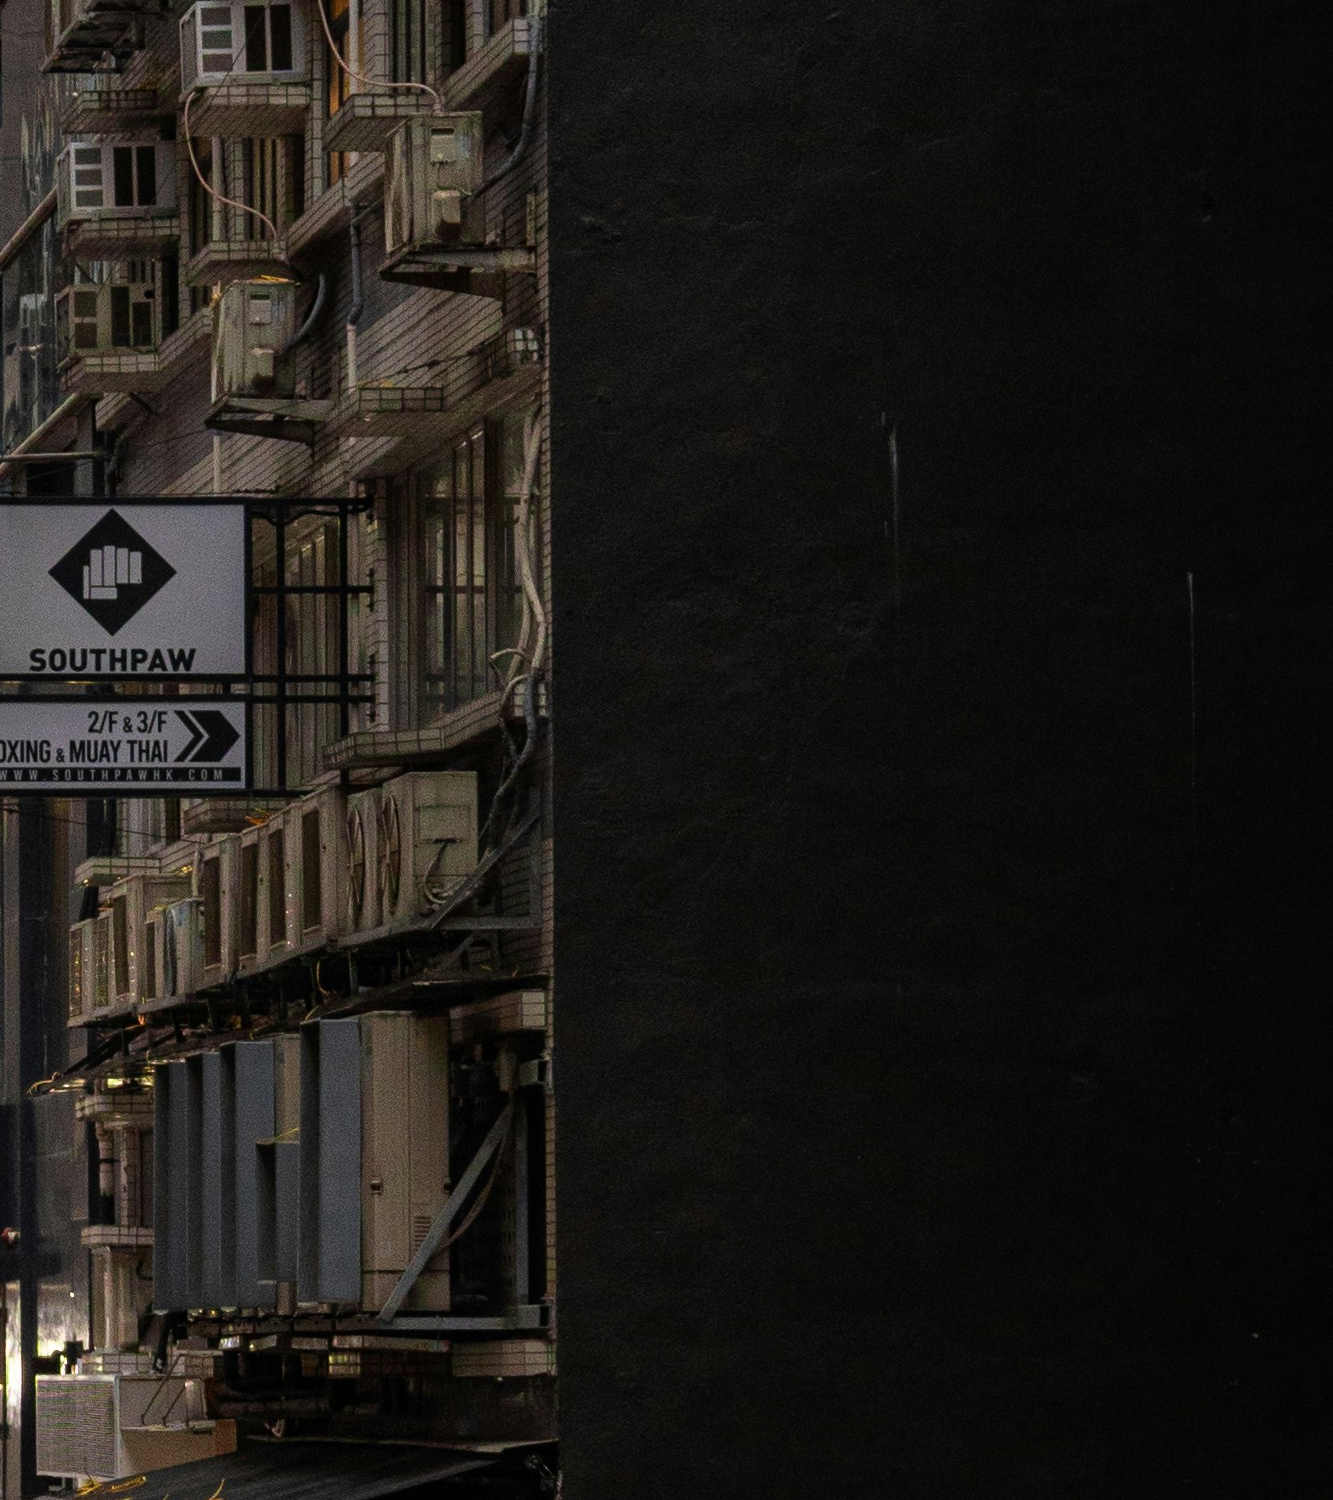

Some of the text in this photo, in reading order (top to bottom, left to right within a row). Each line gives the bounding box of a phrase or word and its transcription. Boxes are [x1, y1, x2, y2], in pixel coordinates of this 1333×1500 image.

[29, 648, 196, 672] SOUTHPAW
[88, 711, 167, 734] 2/F & 3/F
[56, 748, 65, 763] &
[70, 740, 121, 763] MUAY
[127, 740, 167, 763] THAI
[0, 769, 223, 781] WWW.SOUTHPAWHK.COM
